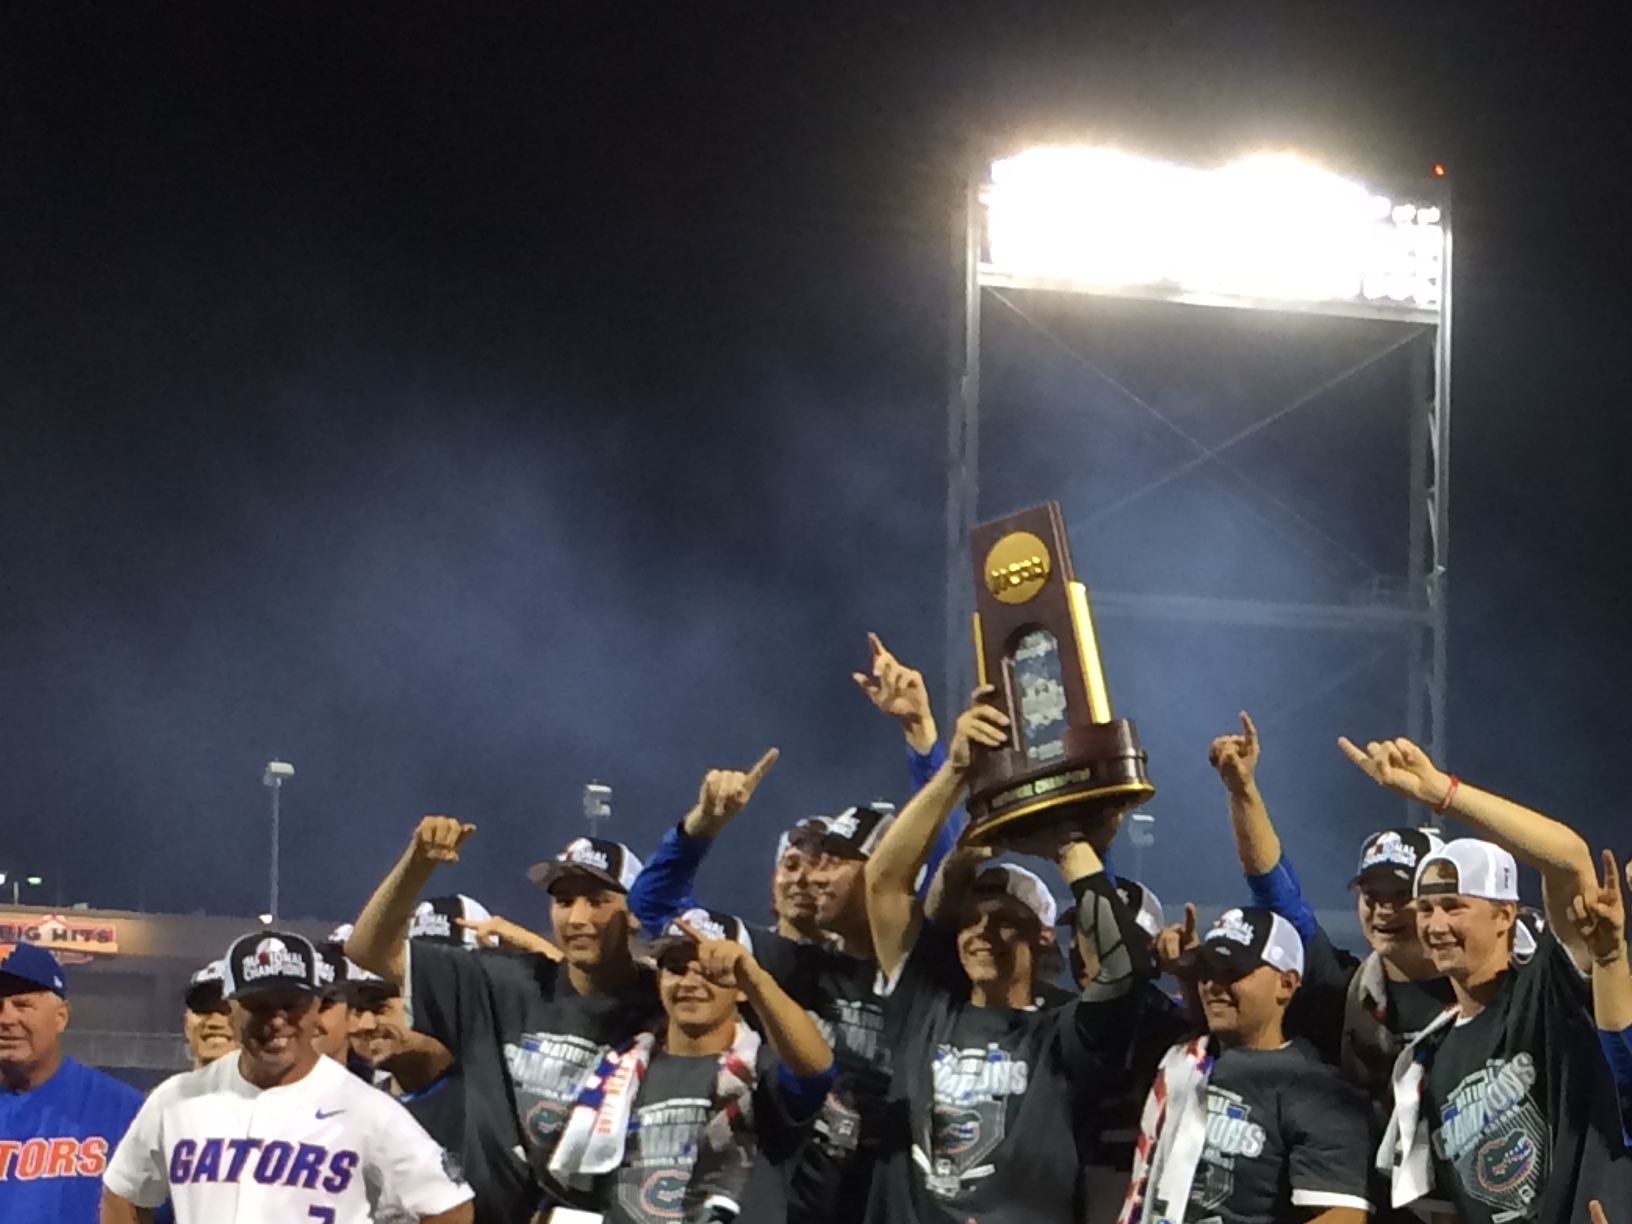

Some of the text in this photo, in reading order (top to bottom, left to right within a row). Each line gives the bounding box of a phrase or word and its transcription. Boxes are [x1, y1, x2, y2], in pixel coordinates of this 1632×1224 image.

[53, 927, 111, 944] HITS
[0, 1136, 108, 1182] TORS
[169, 1138, 360, 1194] GATORS
